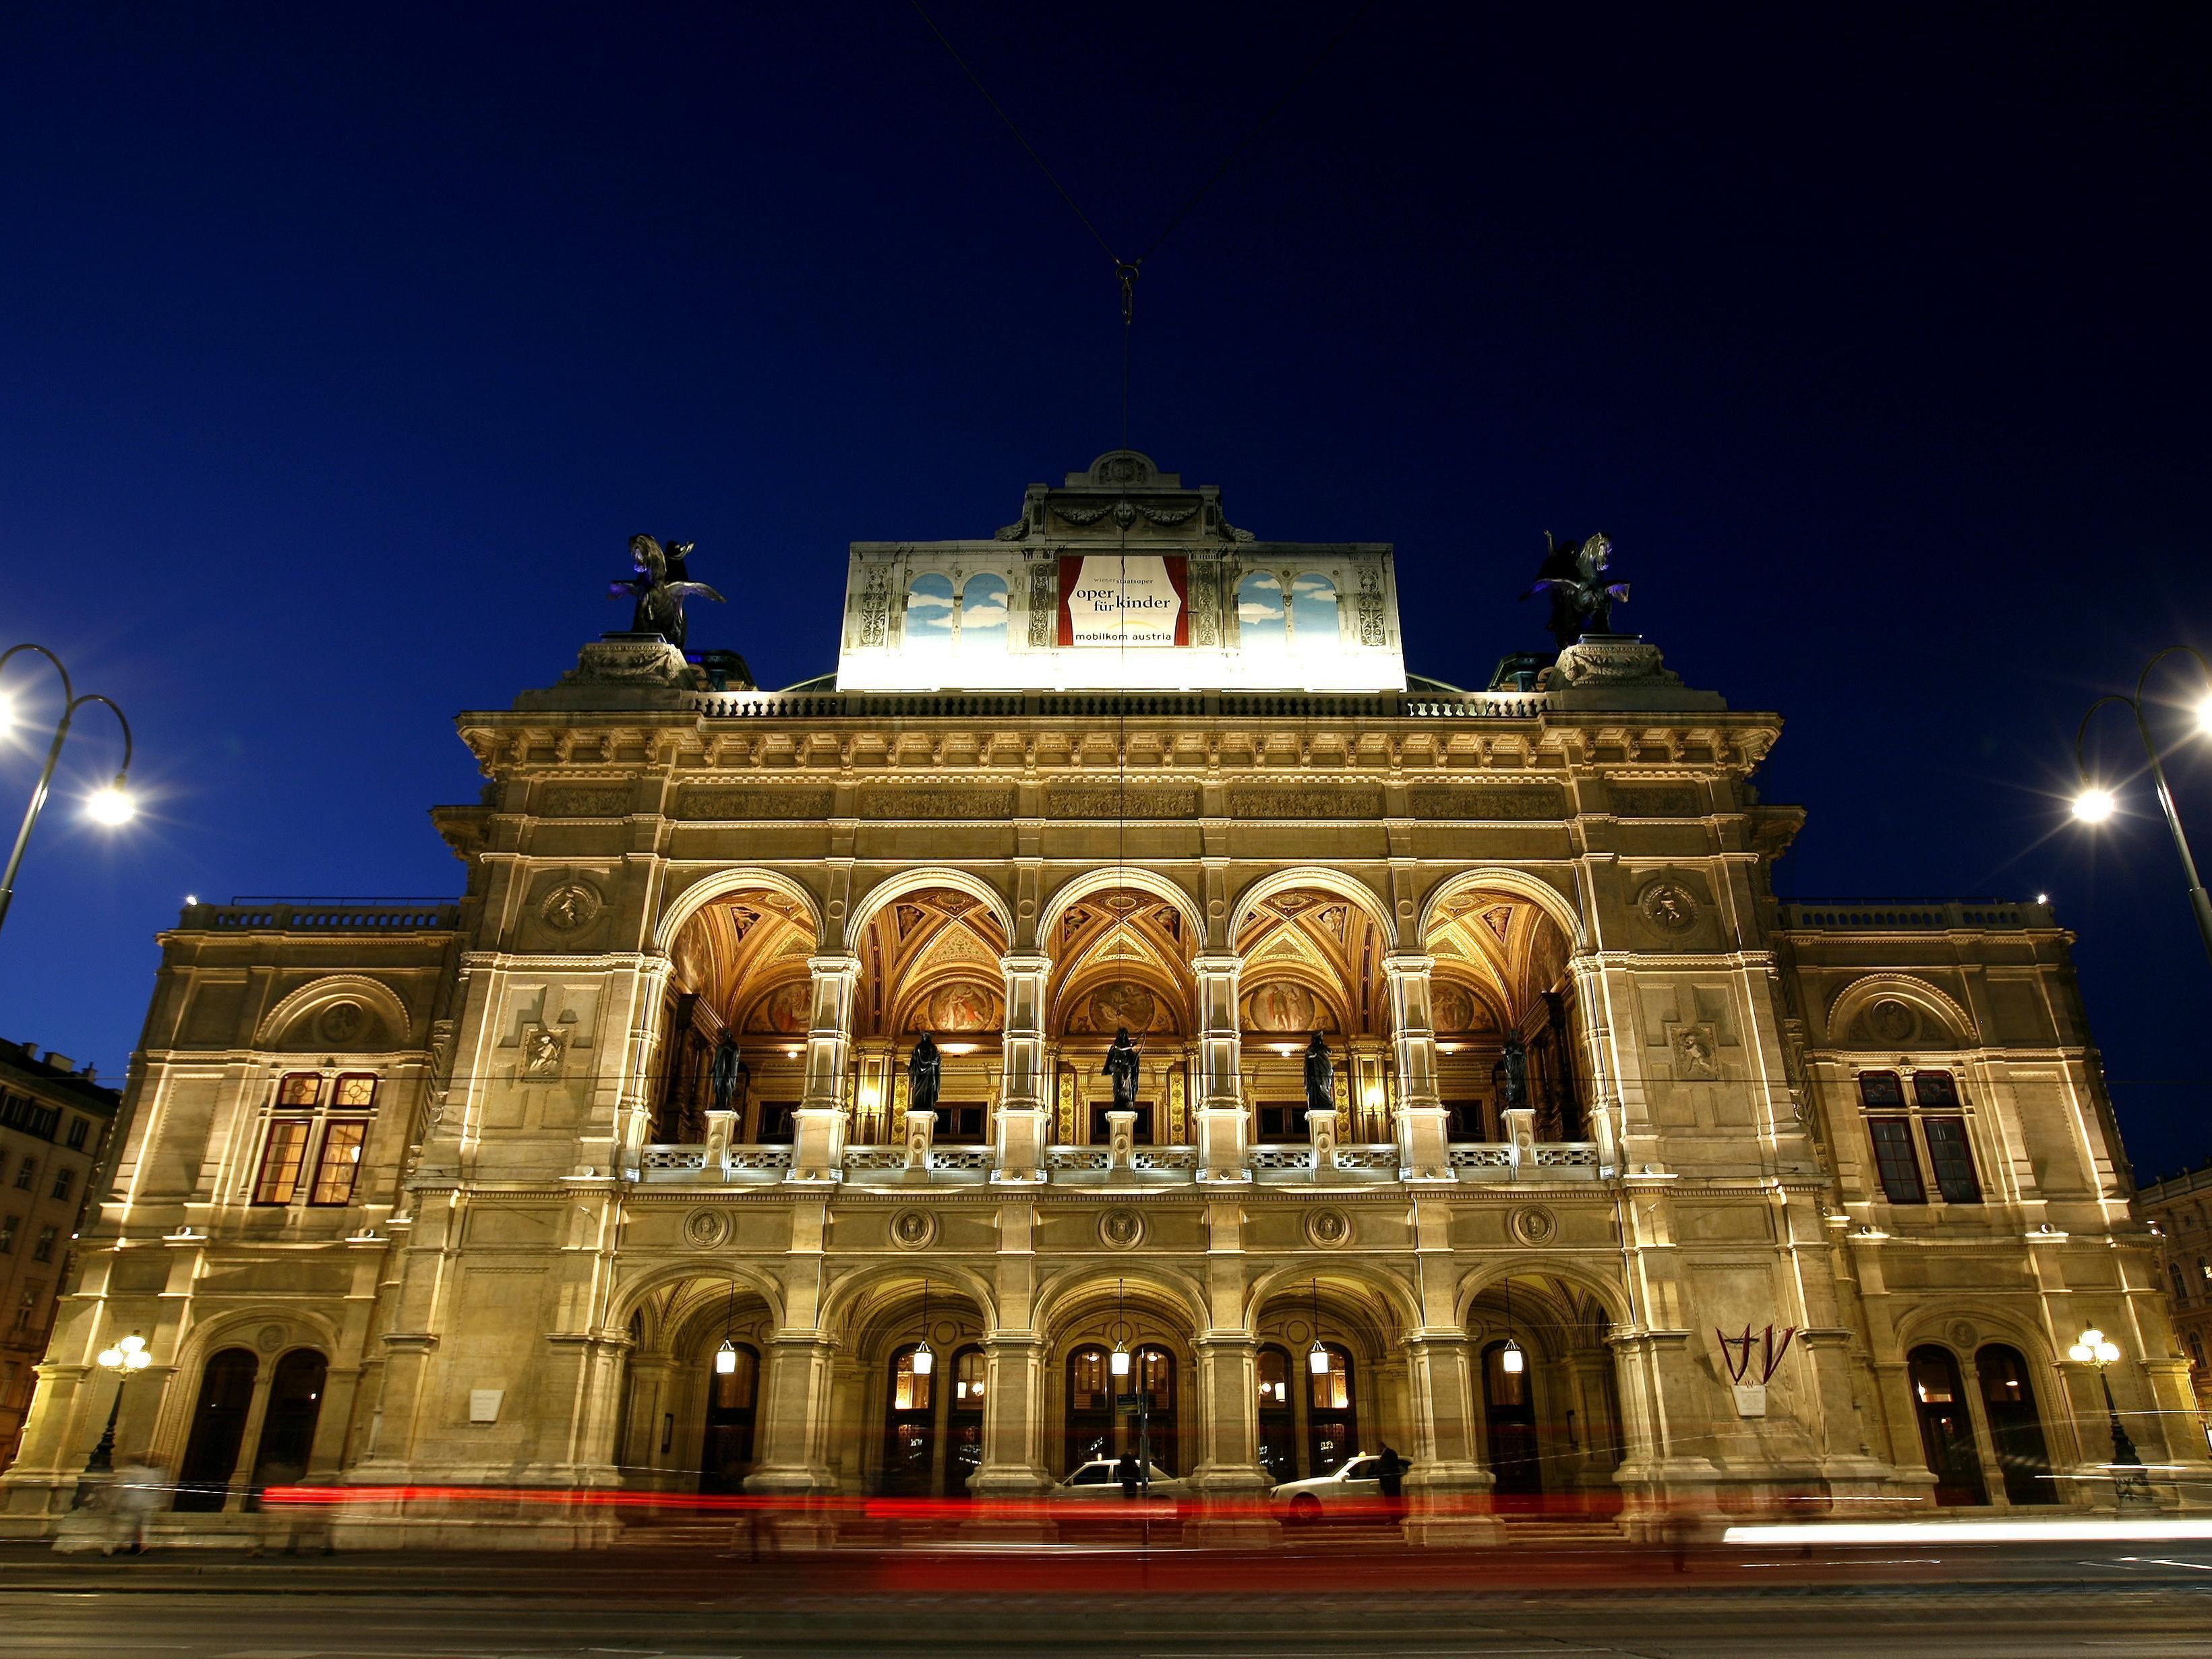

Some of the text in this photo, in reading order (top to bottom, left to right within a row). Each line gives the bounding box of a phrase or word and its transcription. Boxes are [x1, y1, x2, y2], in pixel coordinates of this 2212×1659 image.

[1076, 589, 1114, 601] oper
[1094, 595, 1170, 611] für kinder
